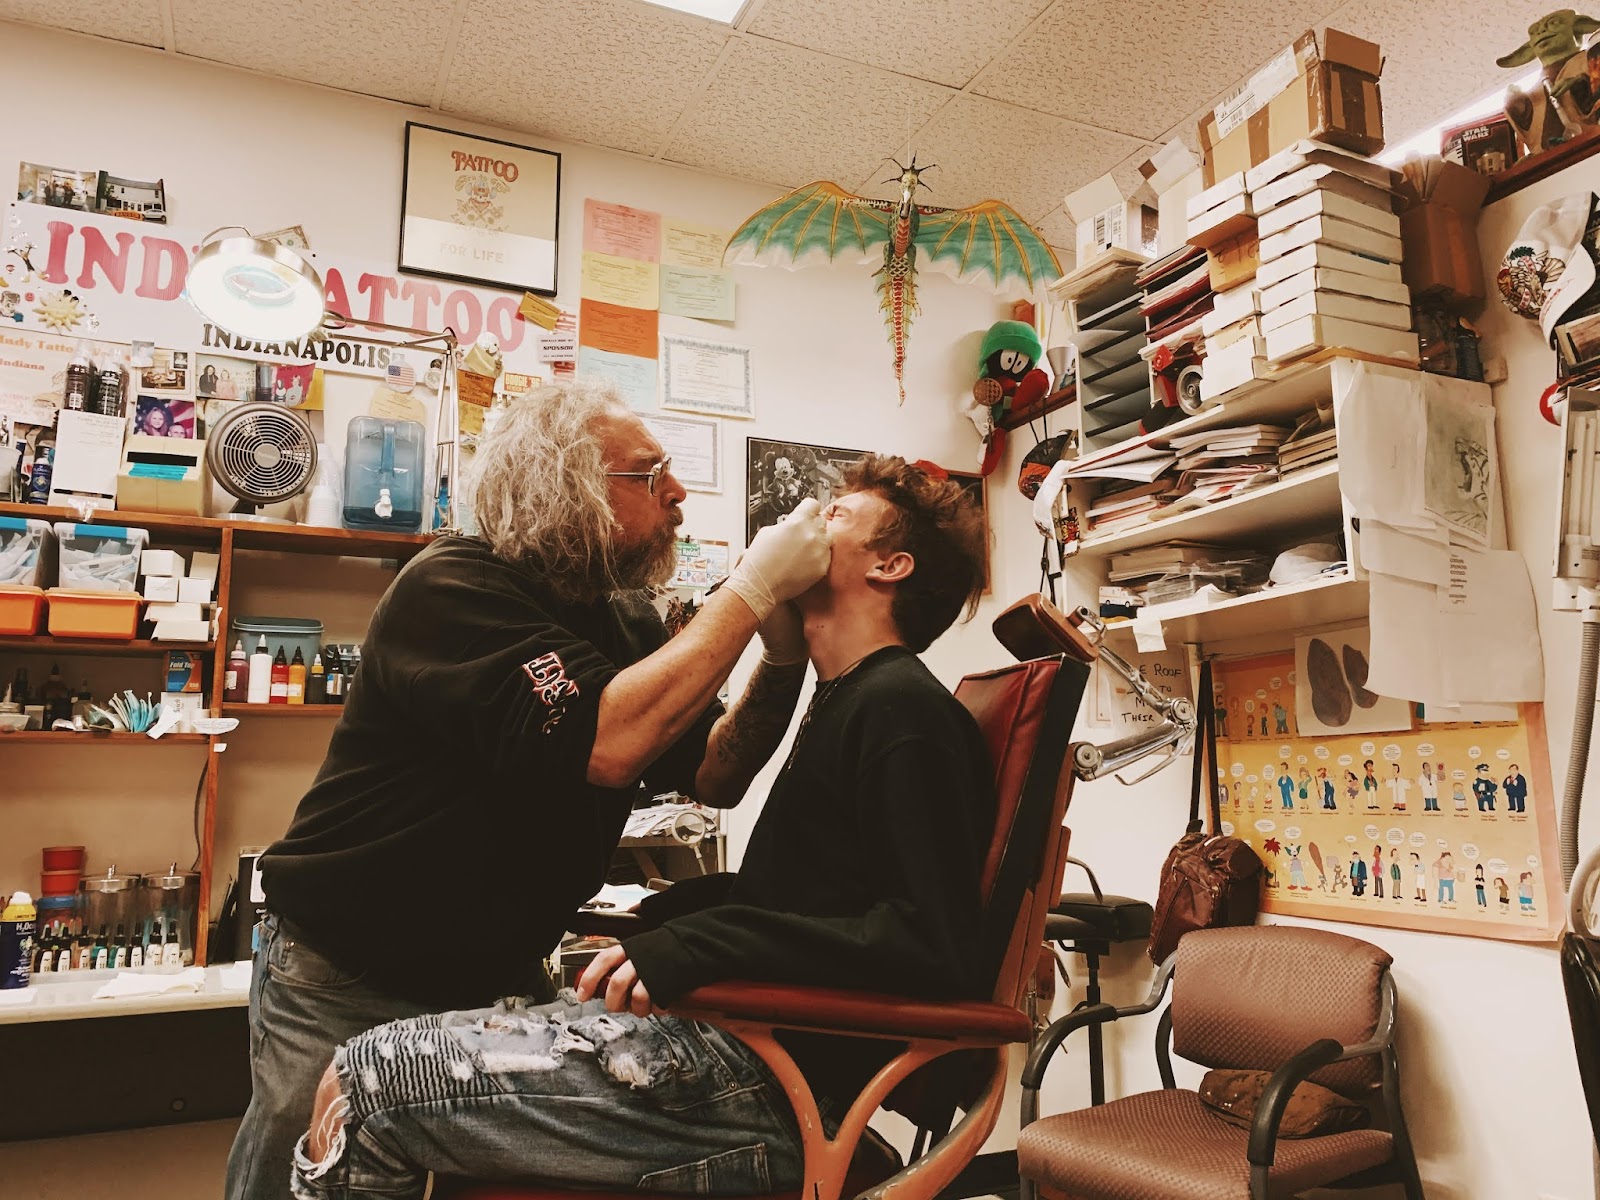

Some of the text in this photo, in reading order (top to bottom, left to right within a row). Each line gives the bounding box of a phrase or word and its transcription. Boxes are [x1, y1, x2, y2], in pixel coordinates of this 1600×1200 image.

[1462, 131, 1489, 142] WARS
[1463, 125, 1489, 136] STAR
[451, 150, 519, 183] TATTOO
[440, 243, 504, 264] FOR LIFE
[45, 220, 200, 302] IND
[323, 267, 526, 352] ATTOO
[1153, 663, 1182, 677] ROOF
[1121, 712, 1155, 724] THEIR
